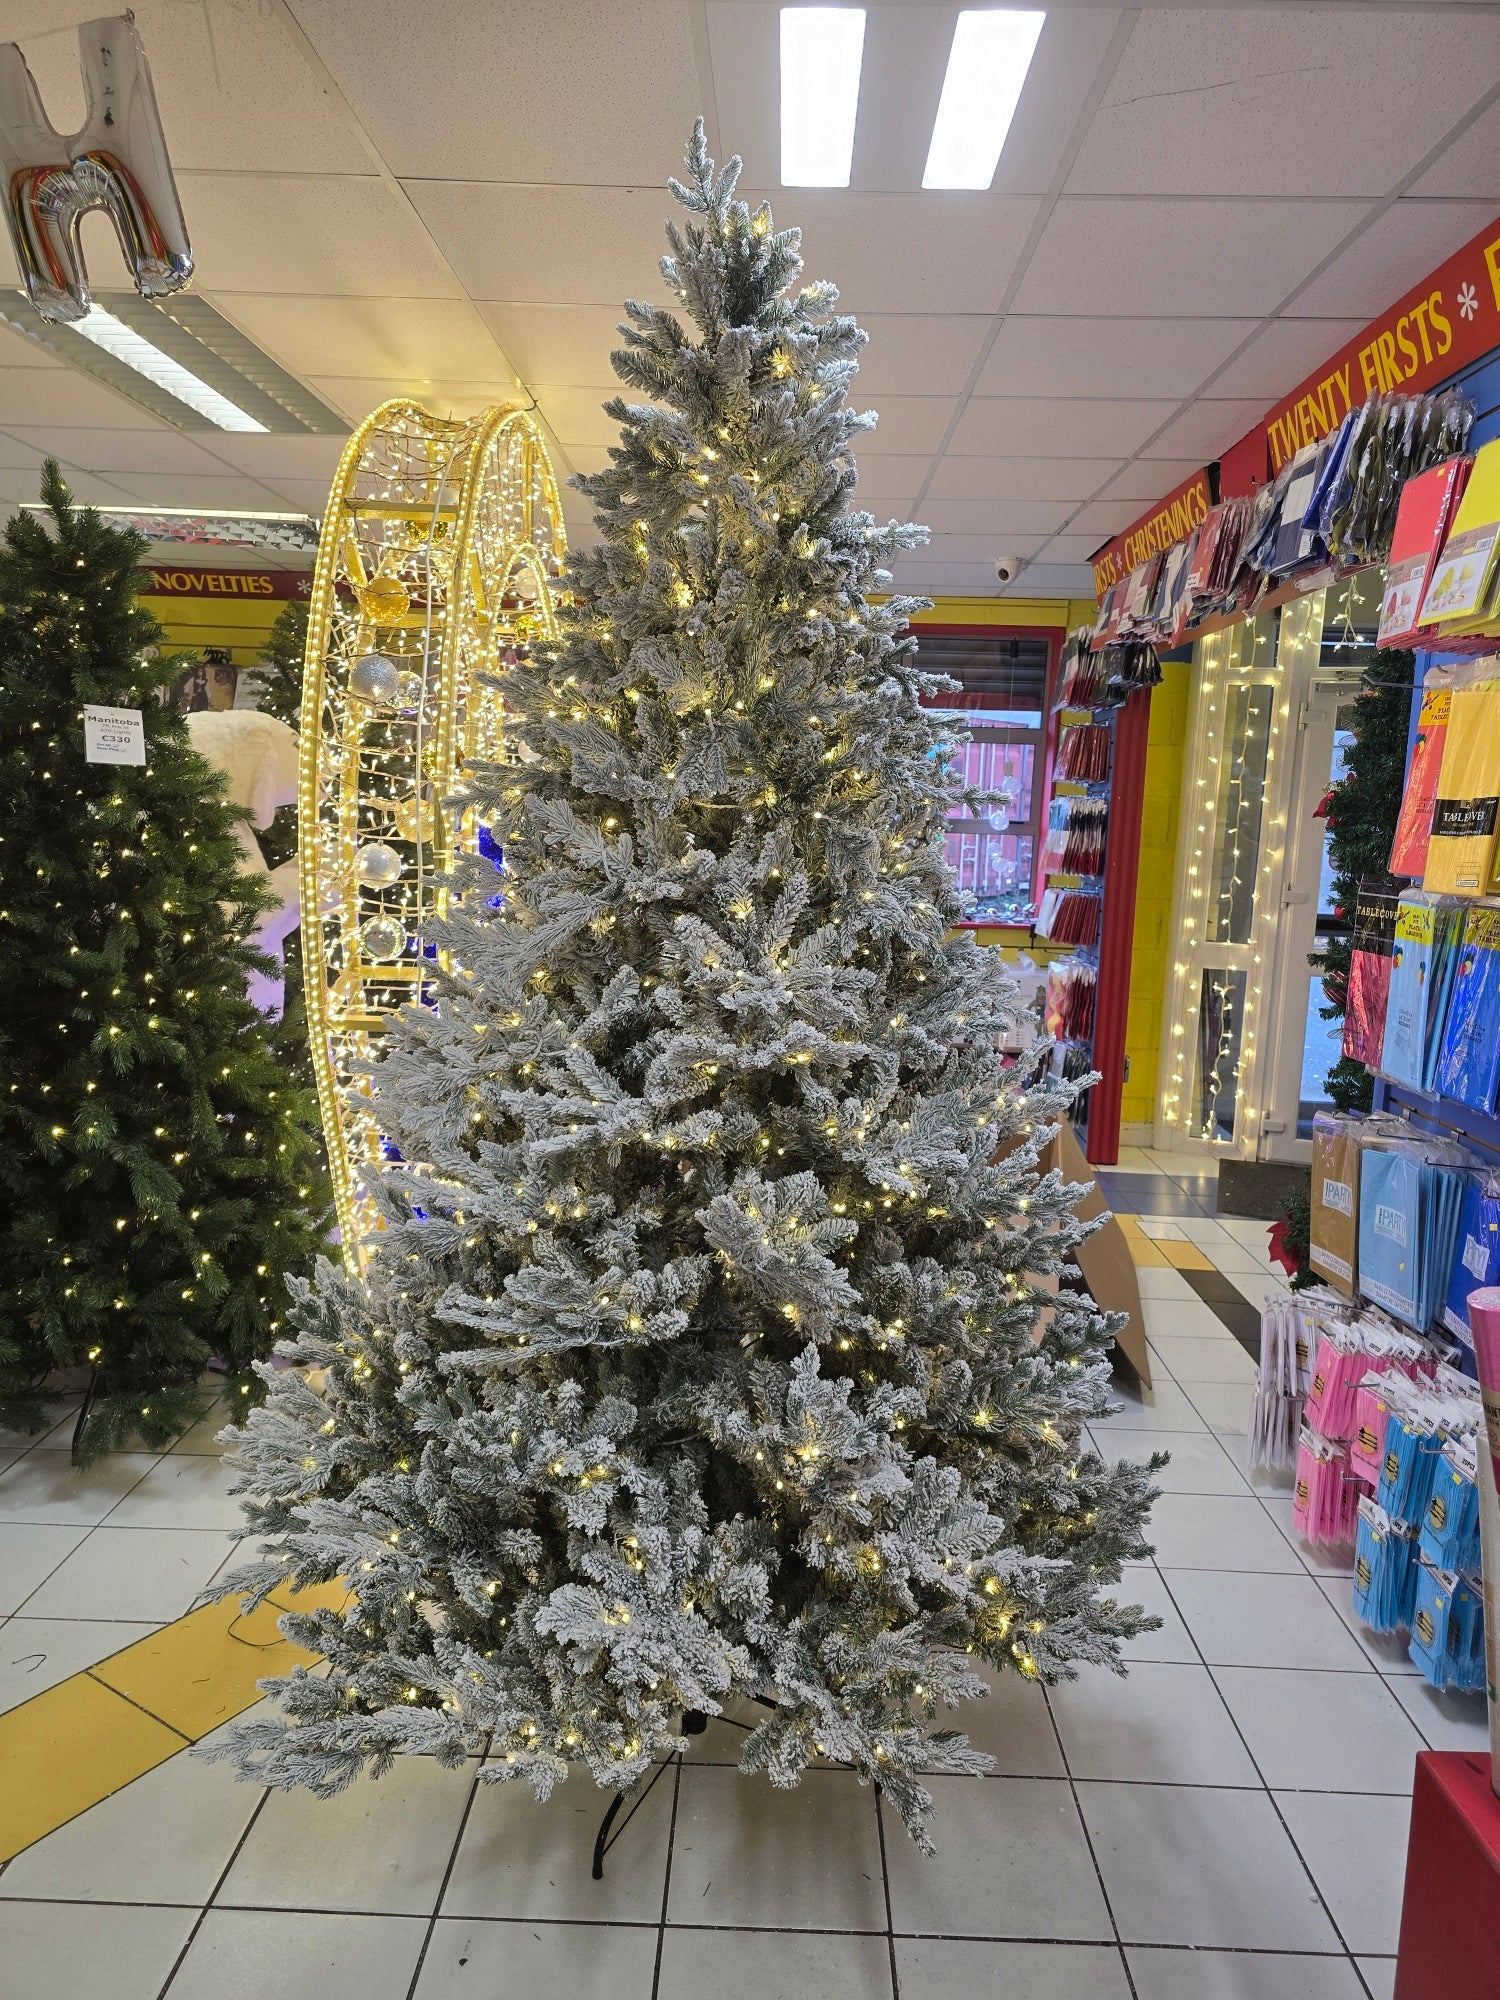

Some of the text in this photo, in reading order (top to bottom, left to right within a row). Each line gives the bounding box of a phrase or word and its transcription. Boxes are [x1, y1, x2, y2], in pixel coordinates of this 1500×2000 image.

[1267, 290, 1453, 469] TWENTY FIRSTS
[1124, 481, 1207, 573] CHRISTENINGS
[155, 572, 274, 594] NOVELTIES
[88, 715, 140, 727] Manitoba
[101, 735, 131, 744] €330
